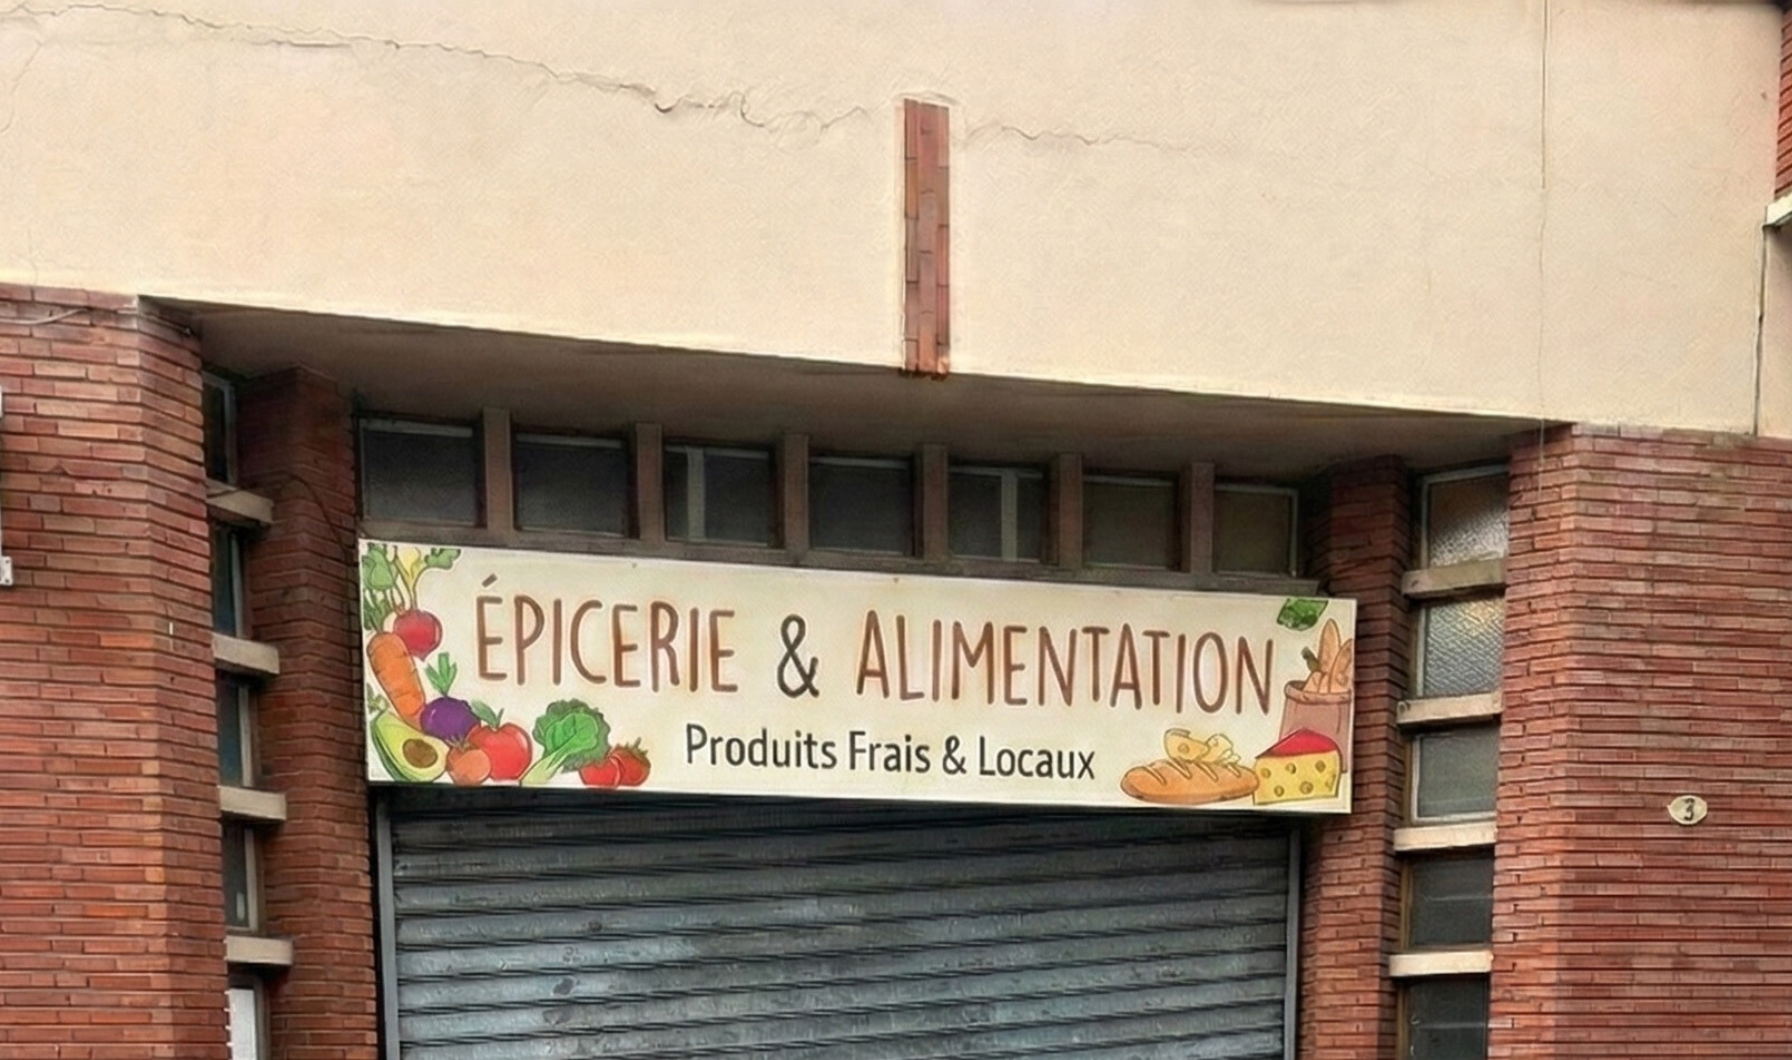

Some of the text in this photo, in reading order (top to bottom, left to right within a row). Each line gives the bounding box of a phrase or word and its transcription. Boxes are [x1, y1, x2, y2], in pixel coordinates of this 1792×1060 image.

[475, 574, 1275, 716] ÉPICERIE & ALIMENTATION
[686, 723, 1096, 780] Produits Frais & Locaux
[1683, 797, 1696, 821] 3
